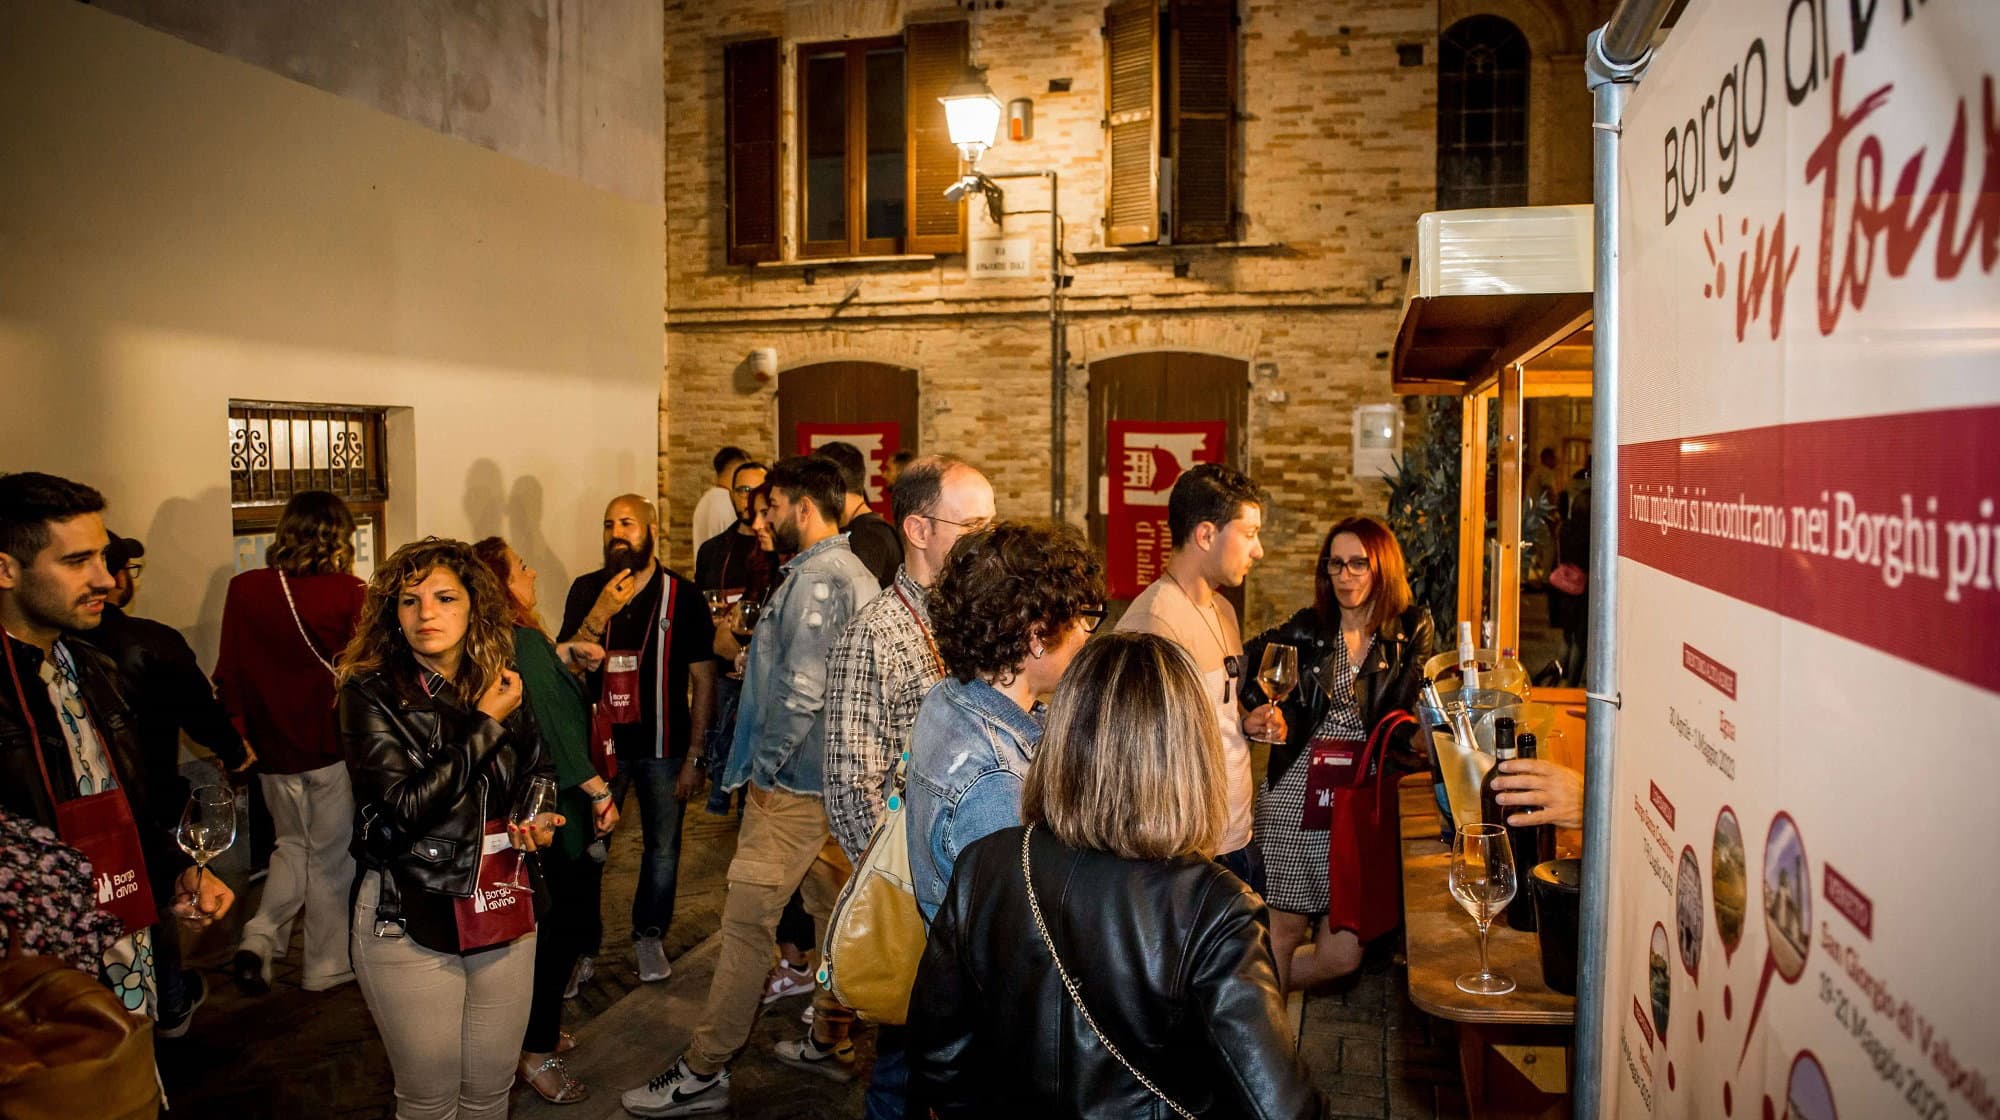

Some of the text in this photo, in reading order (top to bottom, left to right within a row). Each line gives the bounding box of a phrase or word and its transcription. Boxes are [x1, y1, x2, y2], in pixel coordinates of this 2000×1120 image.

[1665, 38, 1768, 226] Borgo
[1736, 212, 1800, 342] in
[1634, 484, 1649, 523] vini
[1650, 484, 1688, 536] migliori
[1690, 486, 1700, 532] si
[1701, 487, 1787, 548] incontrano
[1791, 490, 1829, 556] nei
[1833, 491, 1939, 588] Borghi
[113, 869, 135, 886] Borgo
[485, 887, 511, 900] Borgo
